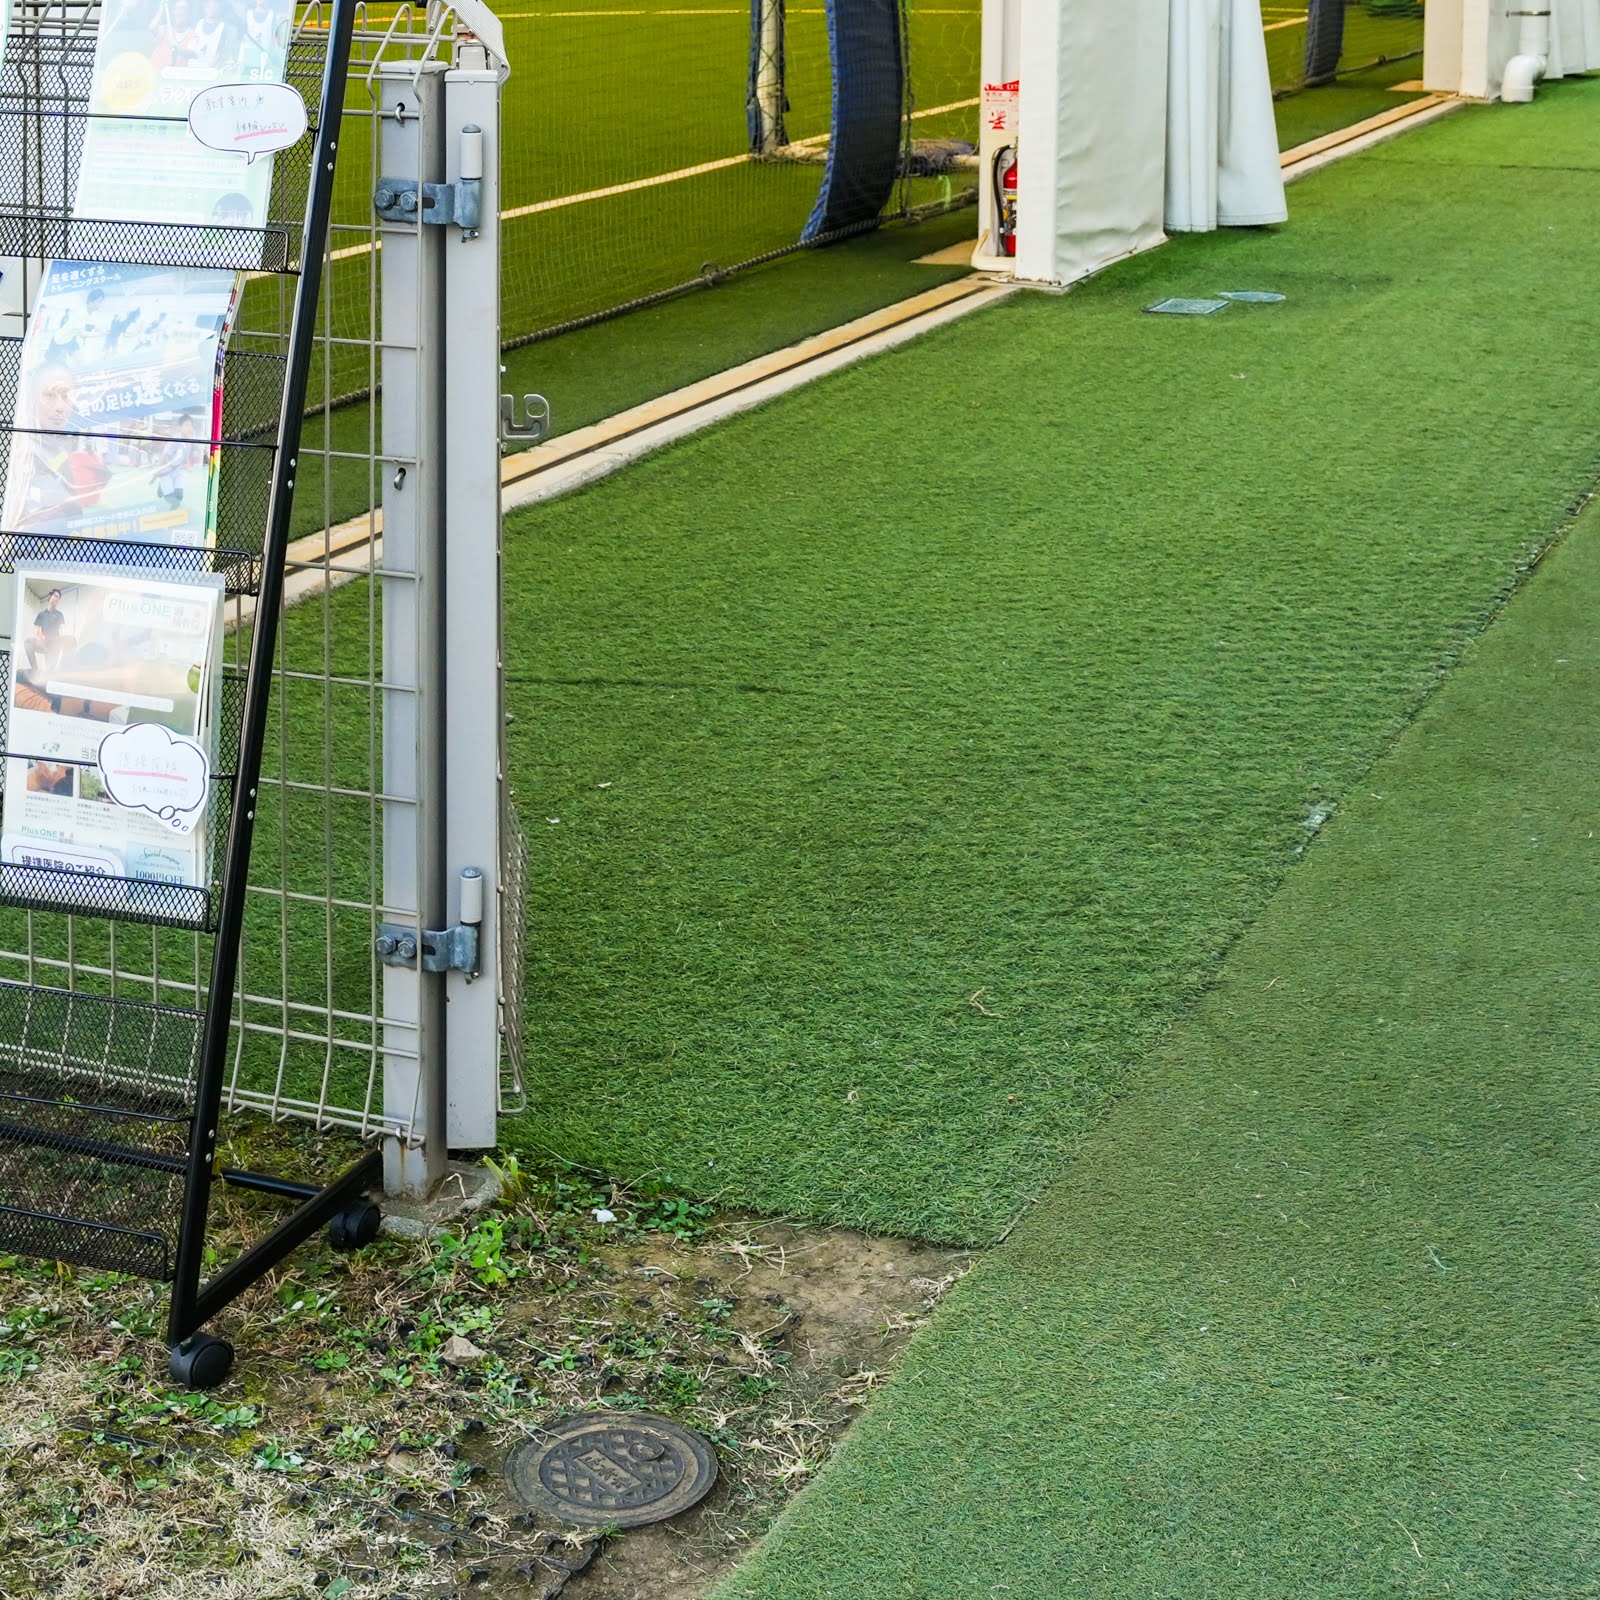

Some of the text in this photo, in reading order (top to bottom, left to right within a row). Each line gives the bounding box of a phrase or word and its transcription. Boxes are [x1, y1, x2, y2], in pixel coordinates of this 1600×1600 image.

[50, 272, 121, 293] トレーニングスクール
[51, 266, 105, 284] 足を速くする
